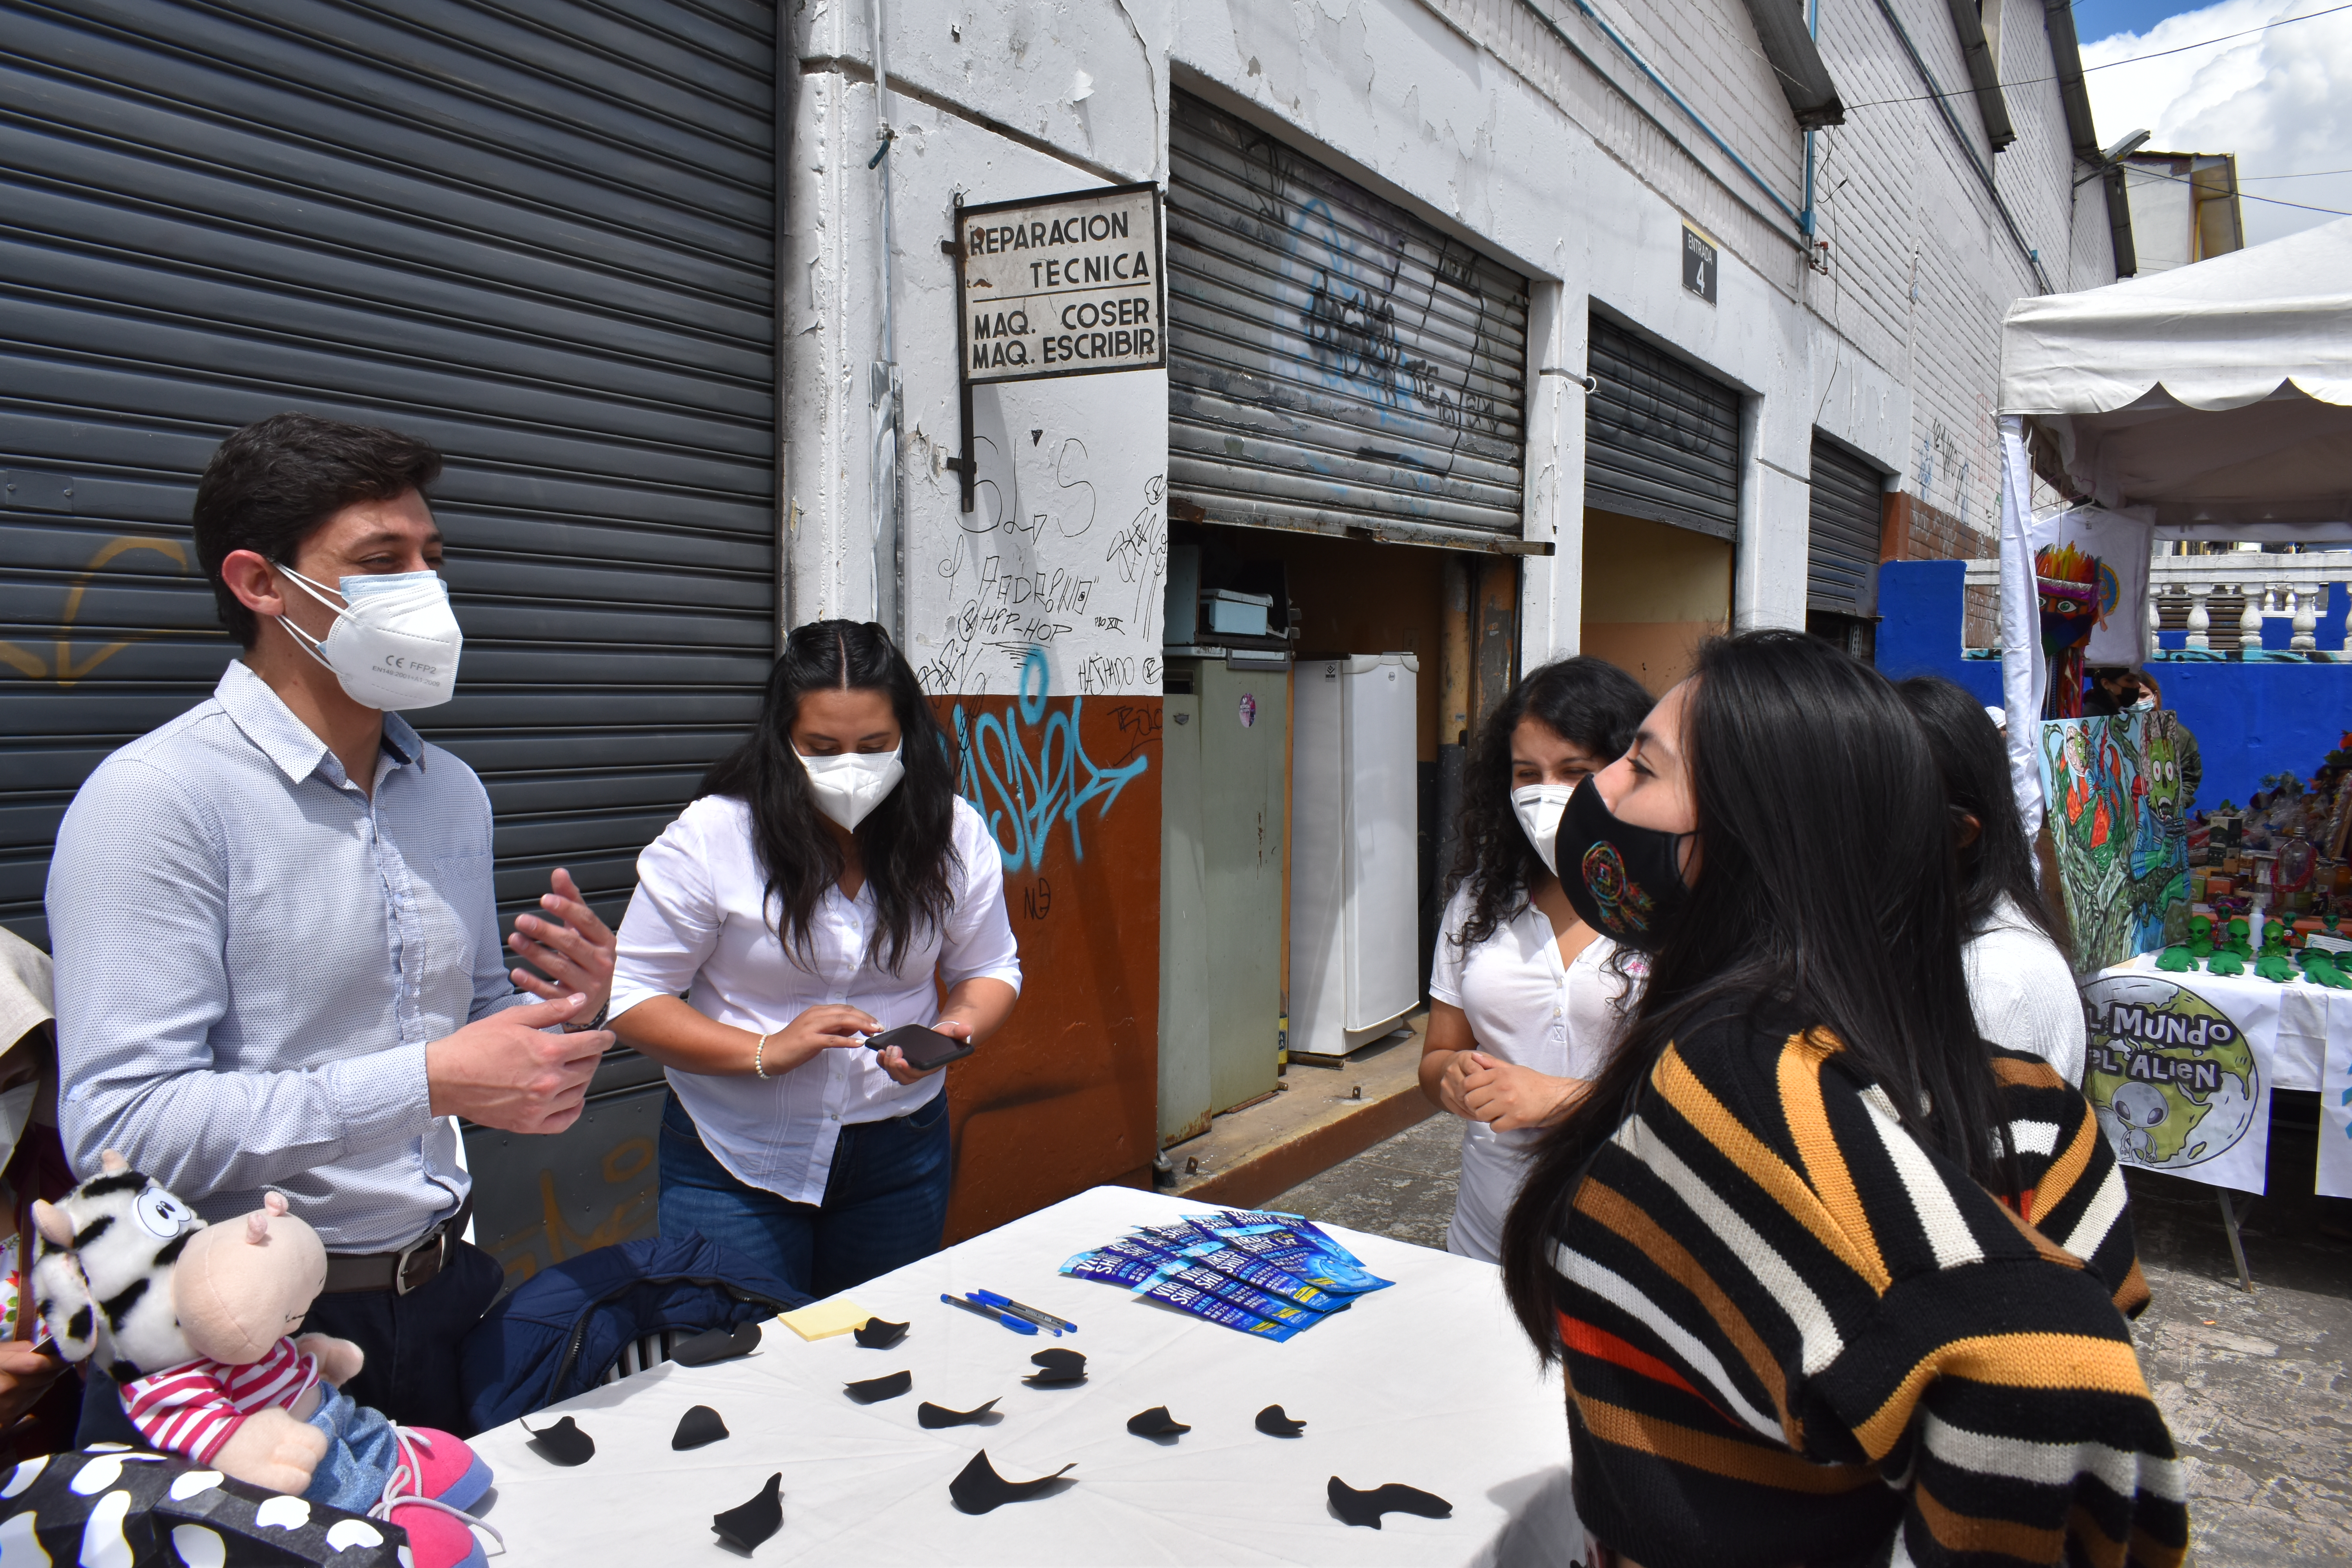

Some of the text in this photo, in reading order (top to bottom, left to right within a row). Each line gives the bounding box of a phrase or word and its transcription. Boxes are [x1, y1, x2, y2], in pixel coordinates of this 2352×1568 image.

[971, 211, 1128, 256] REPARACION
[1688, 233, 1712, 265] ENTRADA
[1030, 251, 1149, 288] TECNICA
[1697, 261, 1705, 294] 4
[975, 298, 1149, 340] MAQ. COSER
[973, 328, 1155, 369] MAQ. ESCRIBIR
[410, 662, 437, 674] FFP2
[1229, 1234, 1269, 1246] VIRUS
[1243, 1239, 1279, 1252] SHUT
[1200, 1249, 1235, 1266] VIRUS
[1216, 1254, 1249, 1273] SHUT
[1195, 1270, 1224, 1289] SHU
[1170, 1286, 1201, 1305] SHU
